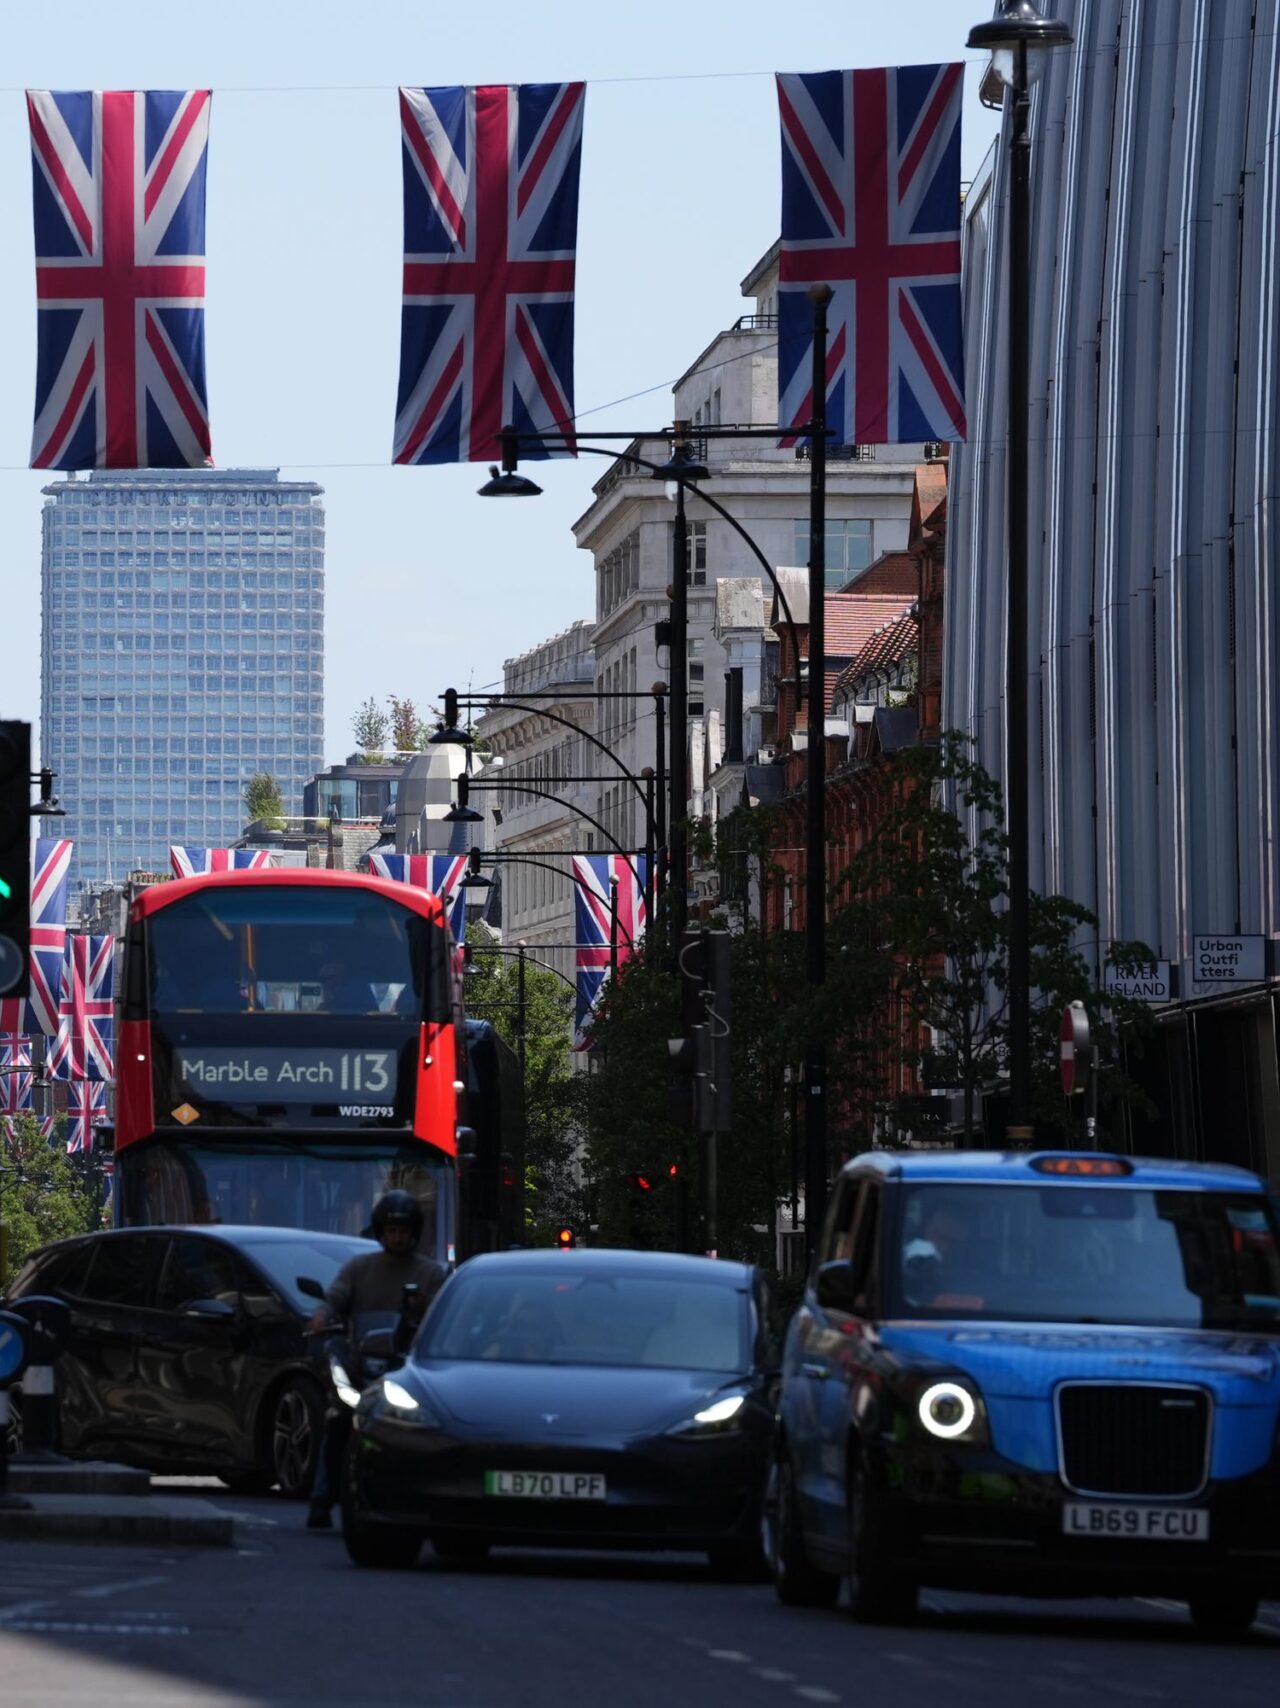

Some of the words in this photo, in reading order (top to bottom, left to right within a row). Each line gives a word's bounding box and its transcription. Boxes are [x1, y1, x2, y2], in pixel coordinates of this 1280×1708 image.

[1199, 940, 1243, 951] Urban
[1199, 953, 1238, 965] Outfi
[1115, 966, 1159, 980] RIVER
[1200, 966, 1235, 977] tters
[1109, 982, 1166, 996] ISLAND
[181, 1058, 268, 1082] Marble
[277, 1058, 333, 1082] Arch
[340, 1053, 389, 1092] 113
[339, 1105, 395, 1118] WDE2793
[497, 1473, 554, 1494] LB70
[560, 1475, 602, 1495] LPF
[1071, 1507, 1140, 1533] LB69
[1146, 1510, 1198, 1536] FCU
